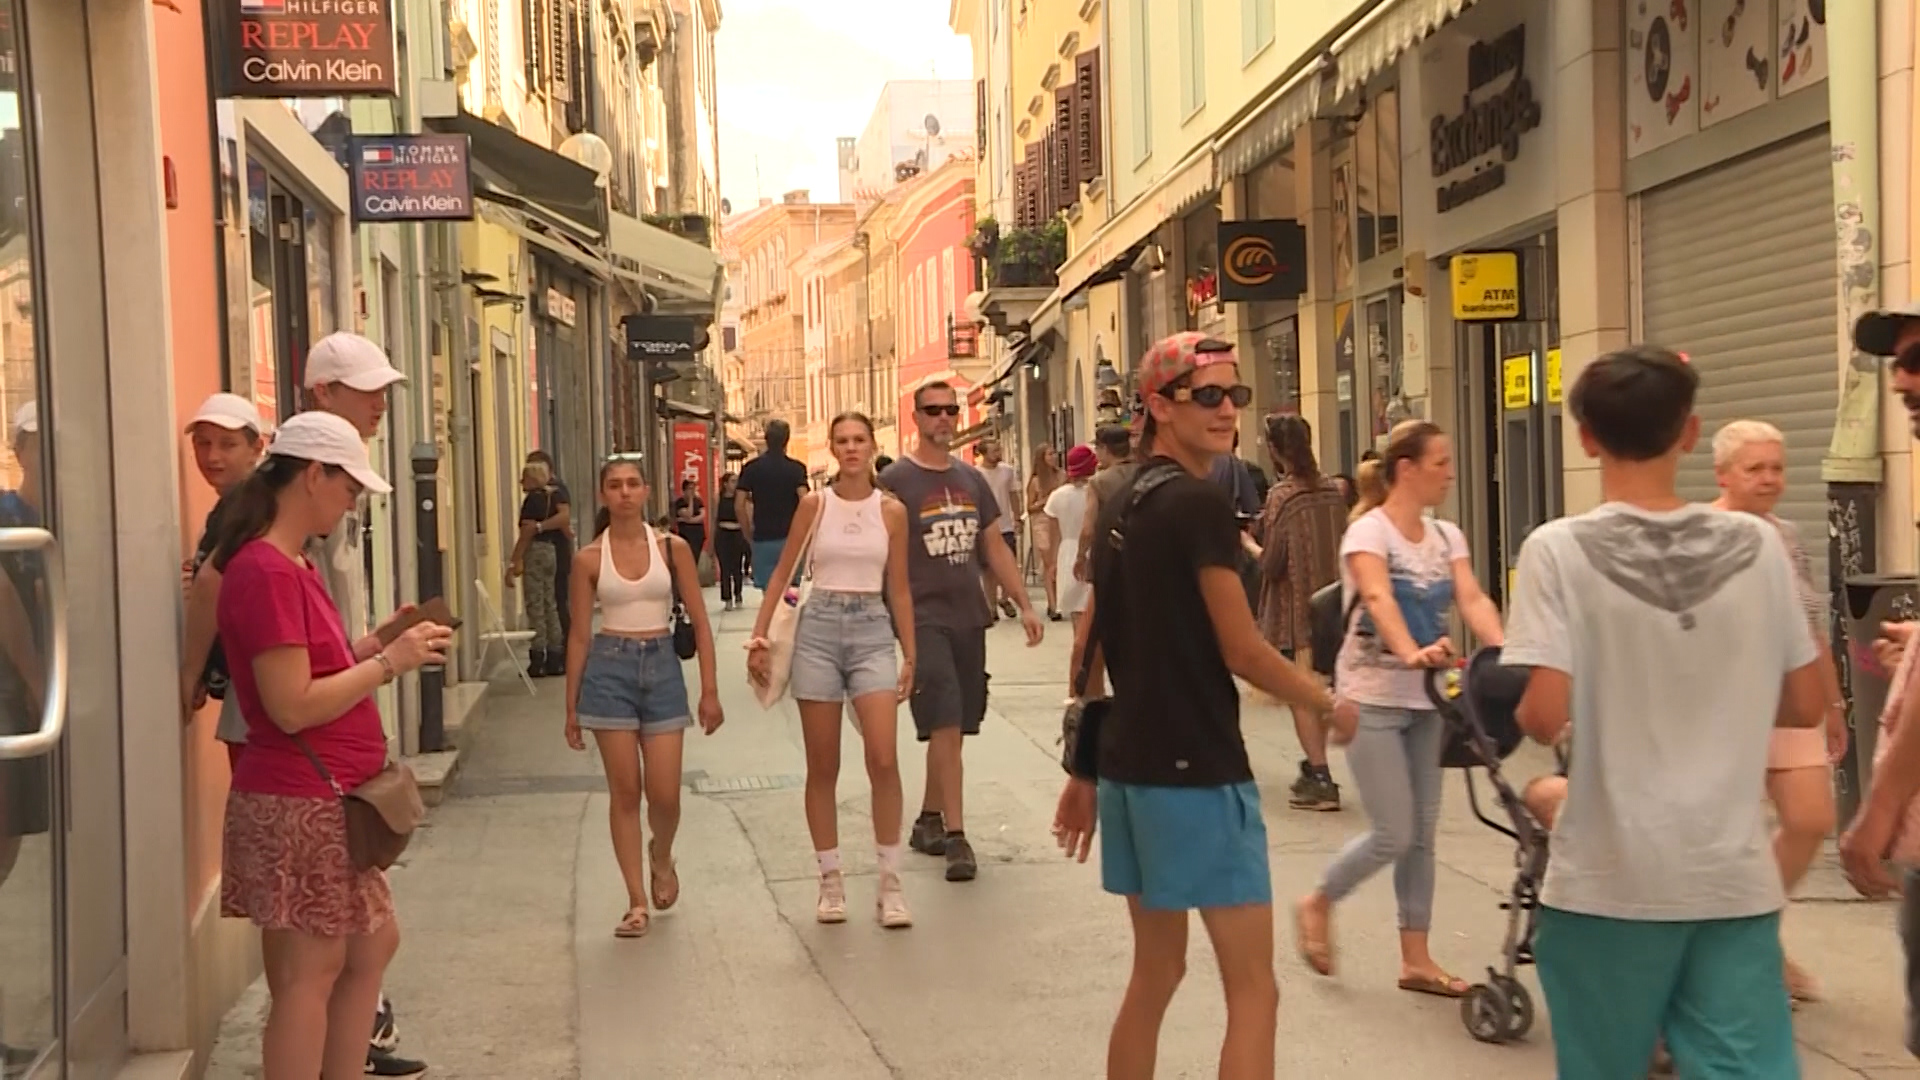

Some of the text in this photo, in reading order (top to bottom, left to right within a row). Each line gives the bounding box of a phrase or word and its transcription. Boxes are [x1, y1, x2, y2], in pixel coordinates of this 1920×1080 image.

[287, 1, 380, 14] HILFIGER
[240, 20, 378, 49] REPLAY
[243, 57, 383, 82] Calvin Klein
[397, 145, 456, 156] TOMMY
[395, 153, 460, 164] HILFIGER
[362, 168, 457, 190] REPLAY
[365, 195, 462, 213] Calvin Klein
[1483, 289, 1516, 300] ATM
[1462, 303, 1516, 313] bankomat
[923, 518, 980, 540] STAR
